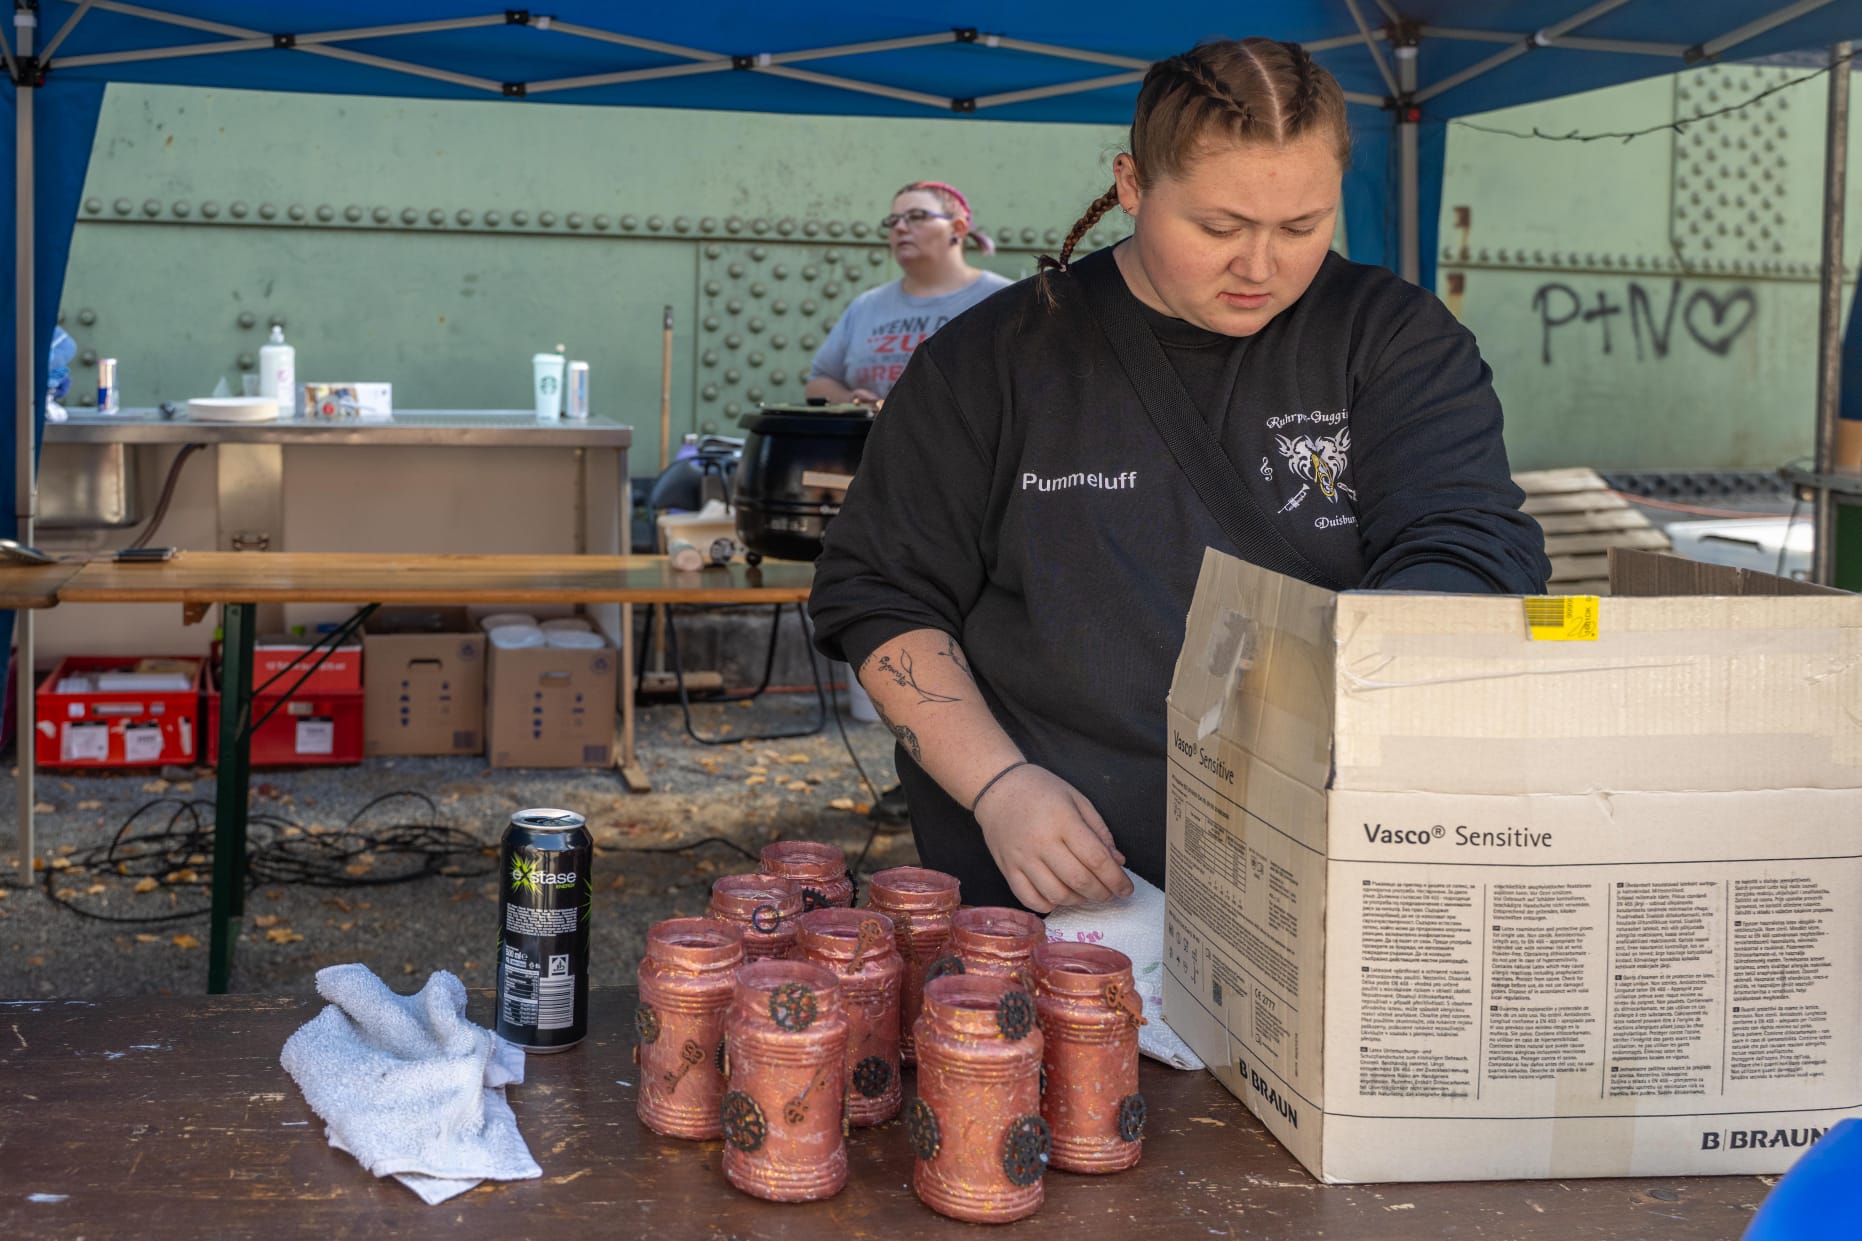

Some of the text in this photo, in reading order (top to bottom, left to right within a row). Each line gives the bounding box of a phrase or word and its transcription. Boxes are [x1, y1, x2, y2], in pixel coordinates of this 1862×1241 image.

[1022, 471, 1137, 491] Pummeluff
[1199, 748, 1234, 784] Sensitive
[1455, 825, 1552, 847] Sensitive
[1250, 1068, 1298, 1129] BRAUN
